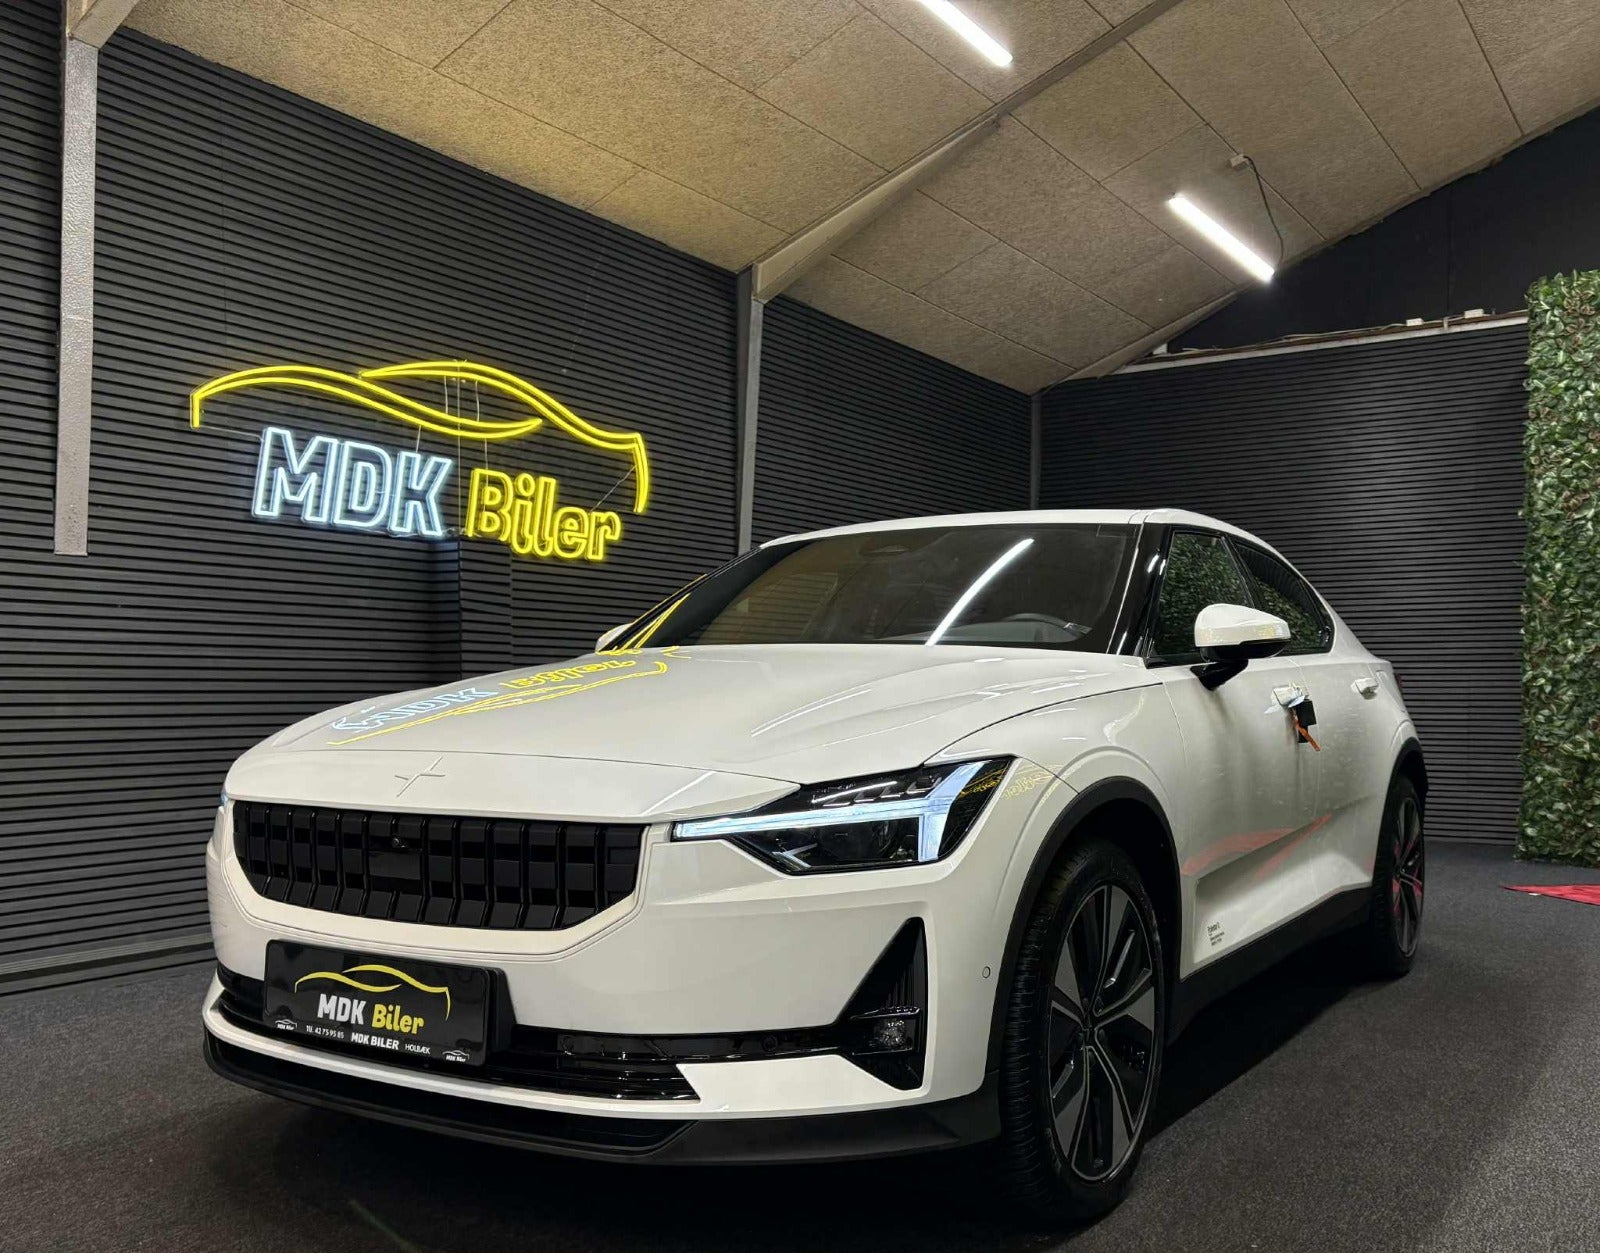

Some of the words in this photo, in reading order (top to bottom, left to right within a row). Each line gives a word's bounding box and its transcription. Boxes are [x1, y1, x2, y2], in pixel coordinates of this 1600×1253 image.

[252, 427, 453, 536] MDK
[465, 467, 622, 560] Biler
[317, 993, 367, 1025] MDK
[371, 1003, 424, 1035] Biler
[315, 1027, 322, 1035] 42
[322, 1028, 329, 1036] 75
[329, 1030, 336, 1038] 95
[351, 1032, 369, 1044] MDK
[370, 1036, 399, 1050] BILER
[404, 1043, 431, 1055] HOLBÆK
